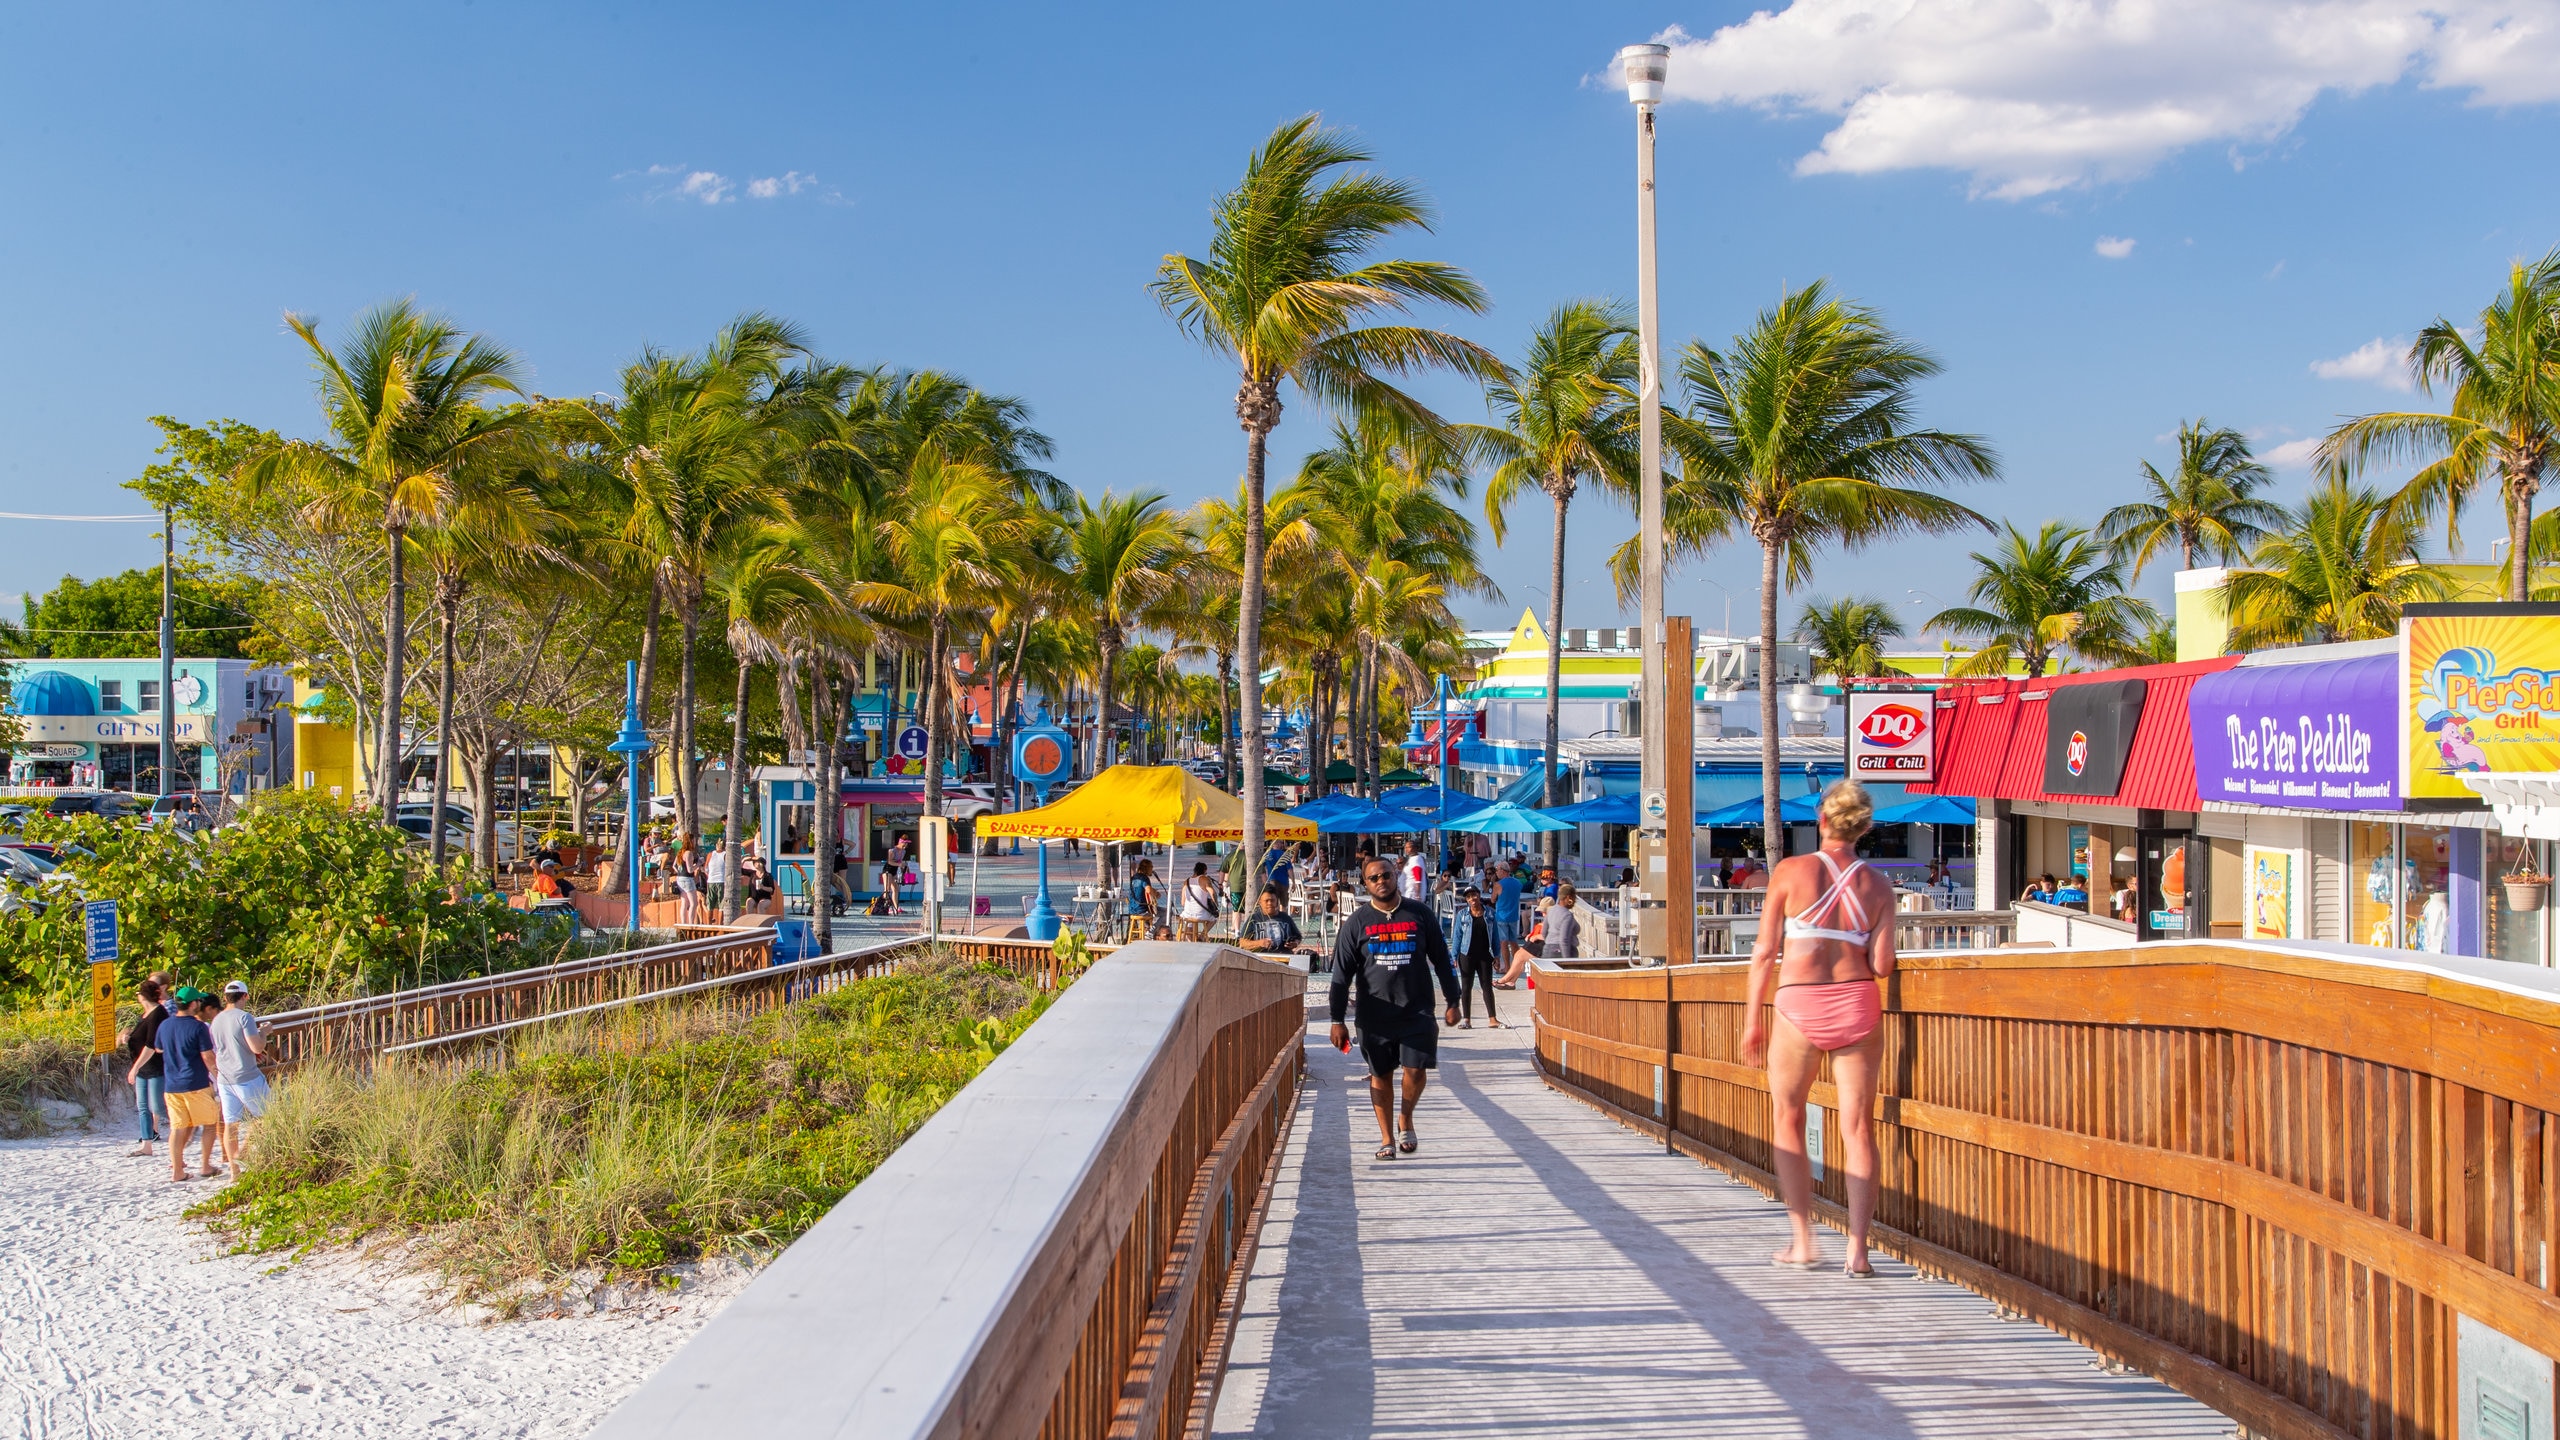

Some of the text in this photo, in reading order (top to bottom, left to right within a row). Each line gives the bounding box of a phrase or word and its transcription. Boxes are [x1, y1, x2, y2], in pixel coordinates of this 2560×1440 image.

[1868, 714, 1916, 741] DQ
[2495, 711, 2539, 729] Grill
[97, 722, 138, 737] GIFT
[2226, 713, 2371, 774] The Pier Peddler
[2477, 733, 2492, 743] and
[2494, 733, 2521, 743] Famous
[2523, 732, 2555, 743] Blowfish
[48, 746, 77, 757] SQUARE
[2071, 741, 2084, 765] DQ
[990, 821, 1160, 838] SUNSET CELEBRATION
[1185, 829, 1229, 839] EVERY
[1365, 922, 1417, 935] LEGENDS
[1379, 932, 1408, 941] IN THE
